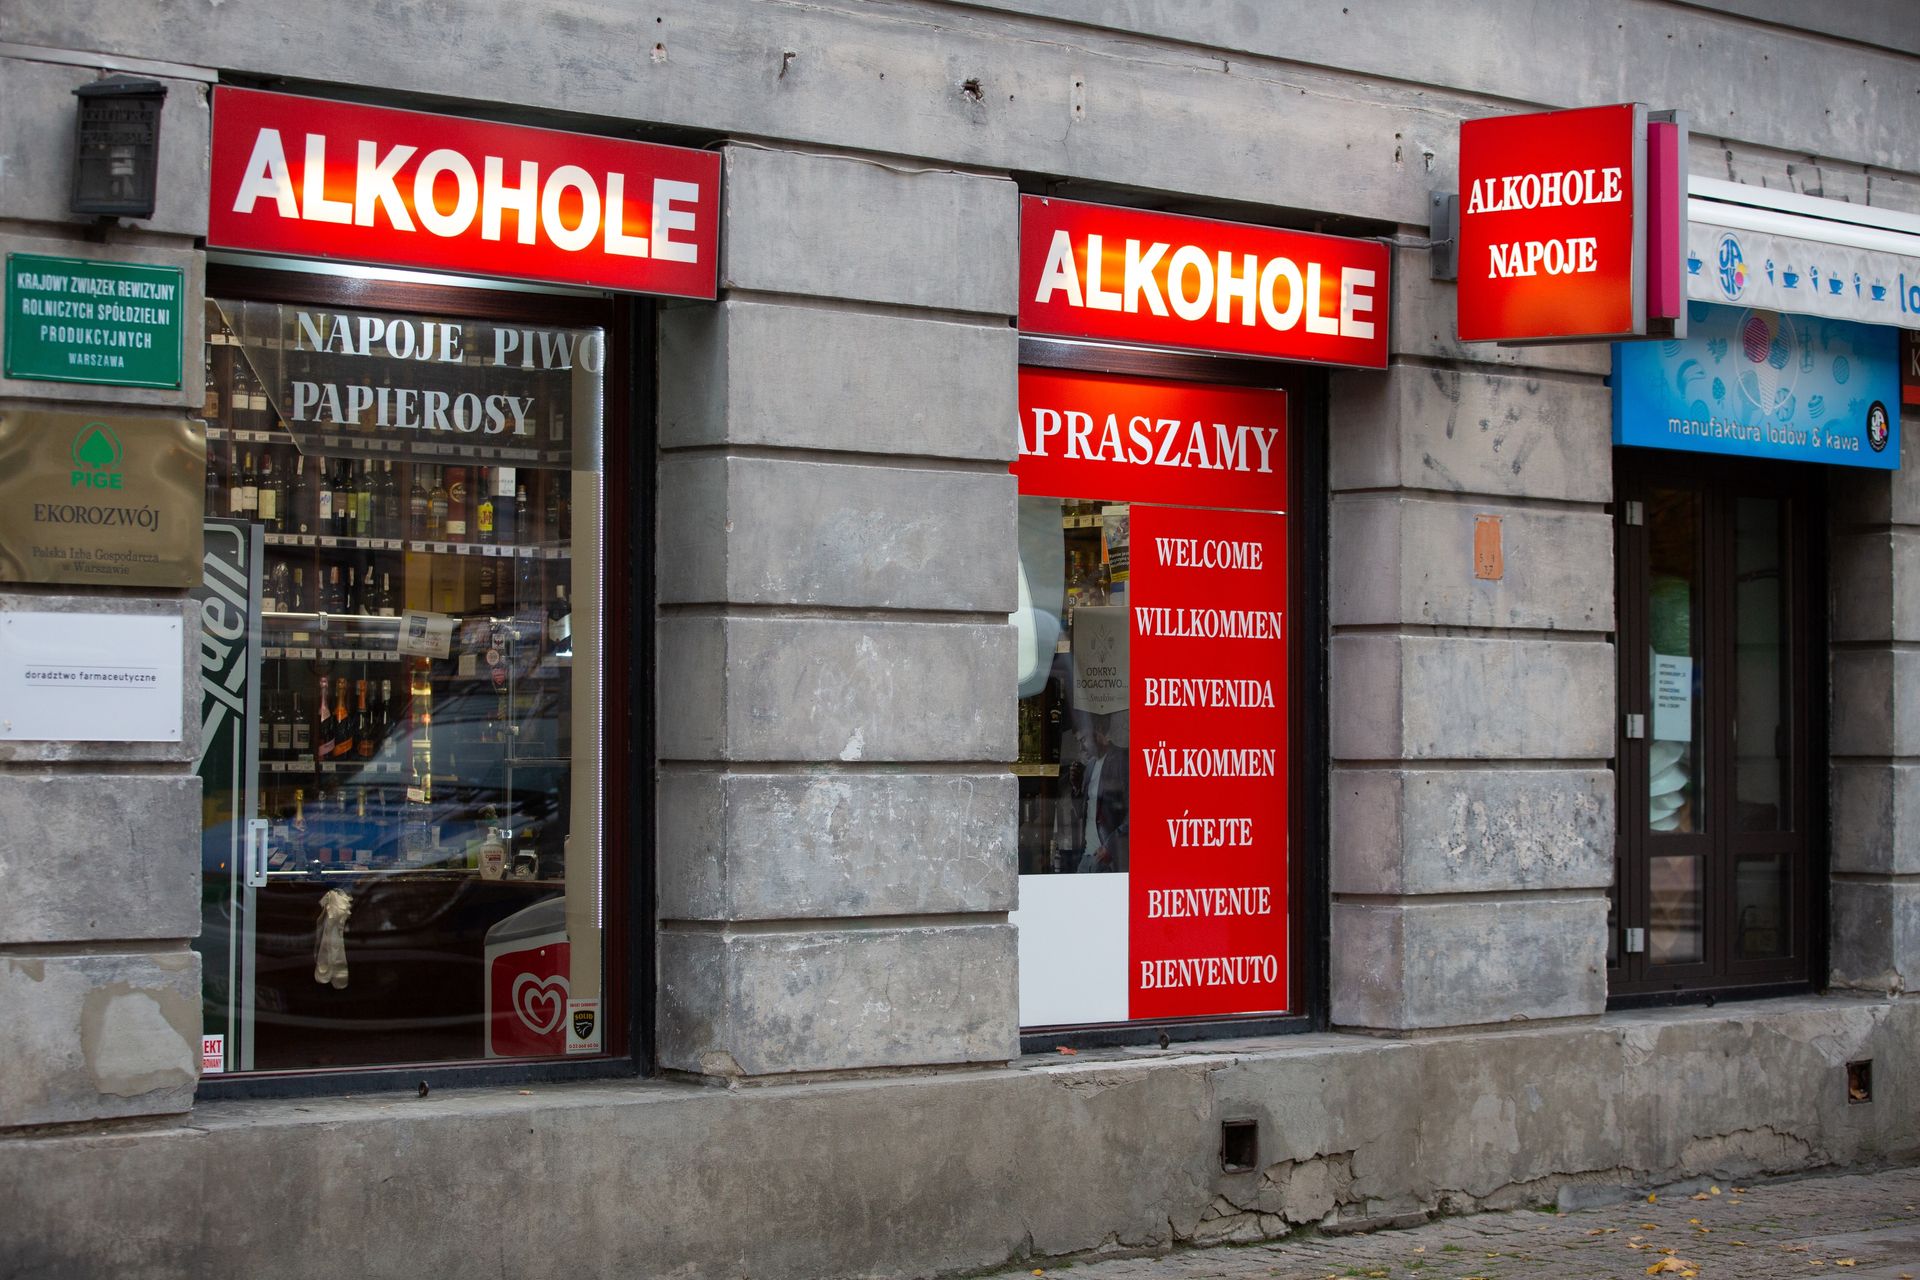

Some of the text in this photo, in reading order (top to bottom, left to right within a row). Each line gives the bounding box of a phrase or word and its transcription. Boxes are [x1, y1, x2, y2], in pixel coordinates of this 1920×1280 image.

[233, 128, 699, 263] ALKOHOLE
[1467, 167, 1623, 214] ALKOHOLE
[1488, 237, 1598, 279] NAPOJE
[17, 272, 175, 301] KRAJOWY ZWIĄZEK REWIZYJNY
[1035, 230, 1376, 340] ALKOHOLE
[22, 298, 170, 325] ROLNICZYCH SPÓŁDZIELNI
[41, 325, 152, 349] PRODUKCYJNYCH
[295, 311, 605, 373] NAPOJE PIWO
[68, 353, 125, 368] WARSZAWA
[291, 382, 535, 435] PAPIEROSY
[1668, 416, 1761, 442] manufaktura
[1766, 423, 1807, 446] lodów
[1812, 428, 1822, 447] &
[1826, 430, 1860, 451] kawa
[70, 470, 123, 490] PIGE
[34, 504, 160, 532] EKOROZWÓJ
[74, 561, 130, 575] Warszawie
[95, 549, 160, 564] Gospodarcza
[1155, 537, 1263, 570] WELCOME
[1135, 607, 1282, 639] WILLKOMMEN
[25, 670, 157, 684] doradztwo farmaceutyczne
[1086, 667, 1117, 677] ODKRYJ
[1145, 678, 1275, 708] BIENVENIDA
[1142, 741, 1276, 778] VÄLKOMMEN
[1167, 810, 1253, 847] VÍTEJTE
[1148, 887, 1271, 918] BIENVENUE
[1140, 955, 1278, 989] BIENVENUTO
[204, 1040, 222, 1053] EKT
